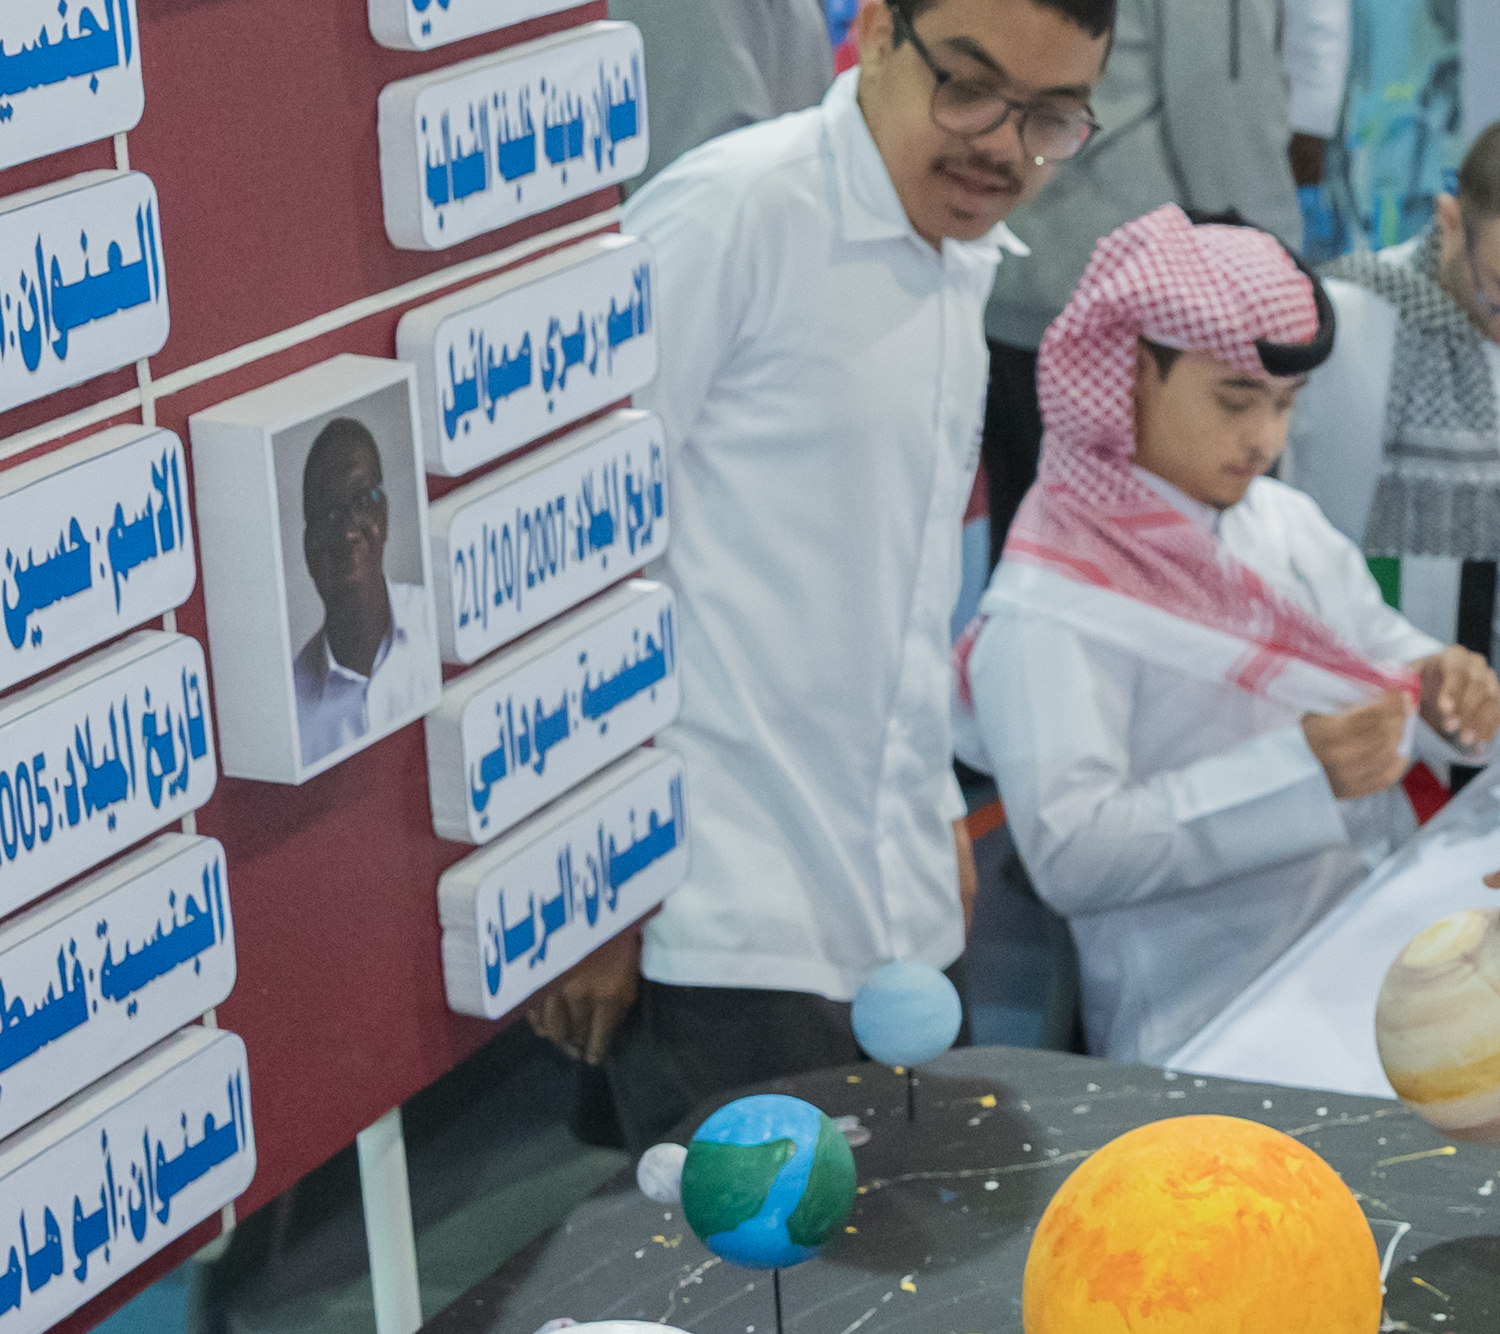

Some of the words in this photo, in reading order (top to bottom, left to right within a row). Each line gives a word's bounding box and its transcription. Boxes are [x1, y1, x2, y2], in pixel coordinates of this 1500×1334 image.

[492, 94, 539, 200] خليفة
[0, 448, 186, 651] الاسم:حسين
[622, 447, 666, 555] تاريخ
[139, 668, 209, 810] تاريخ
